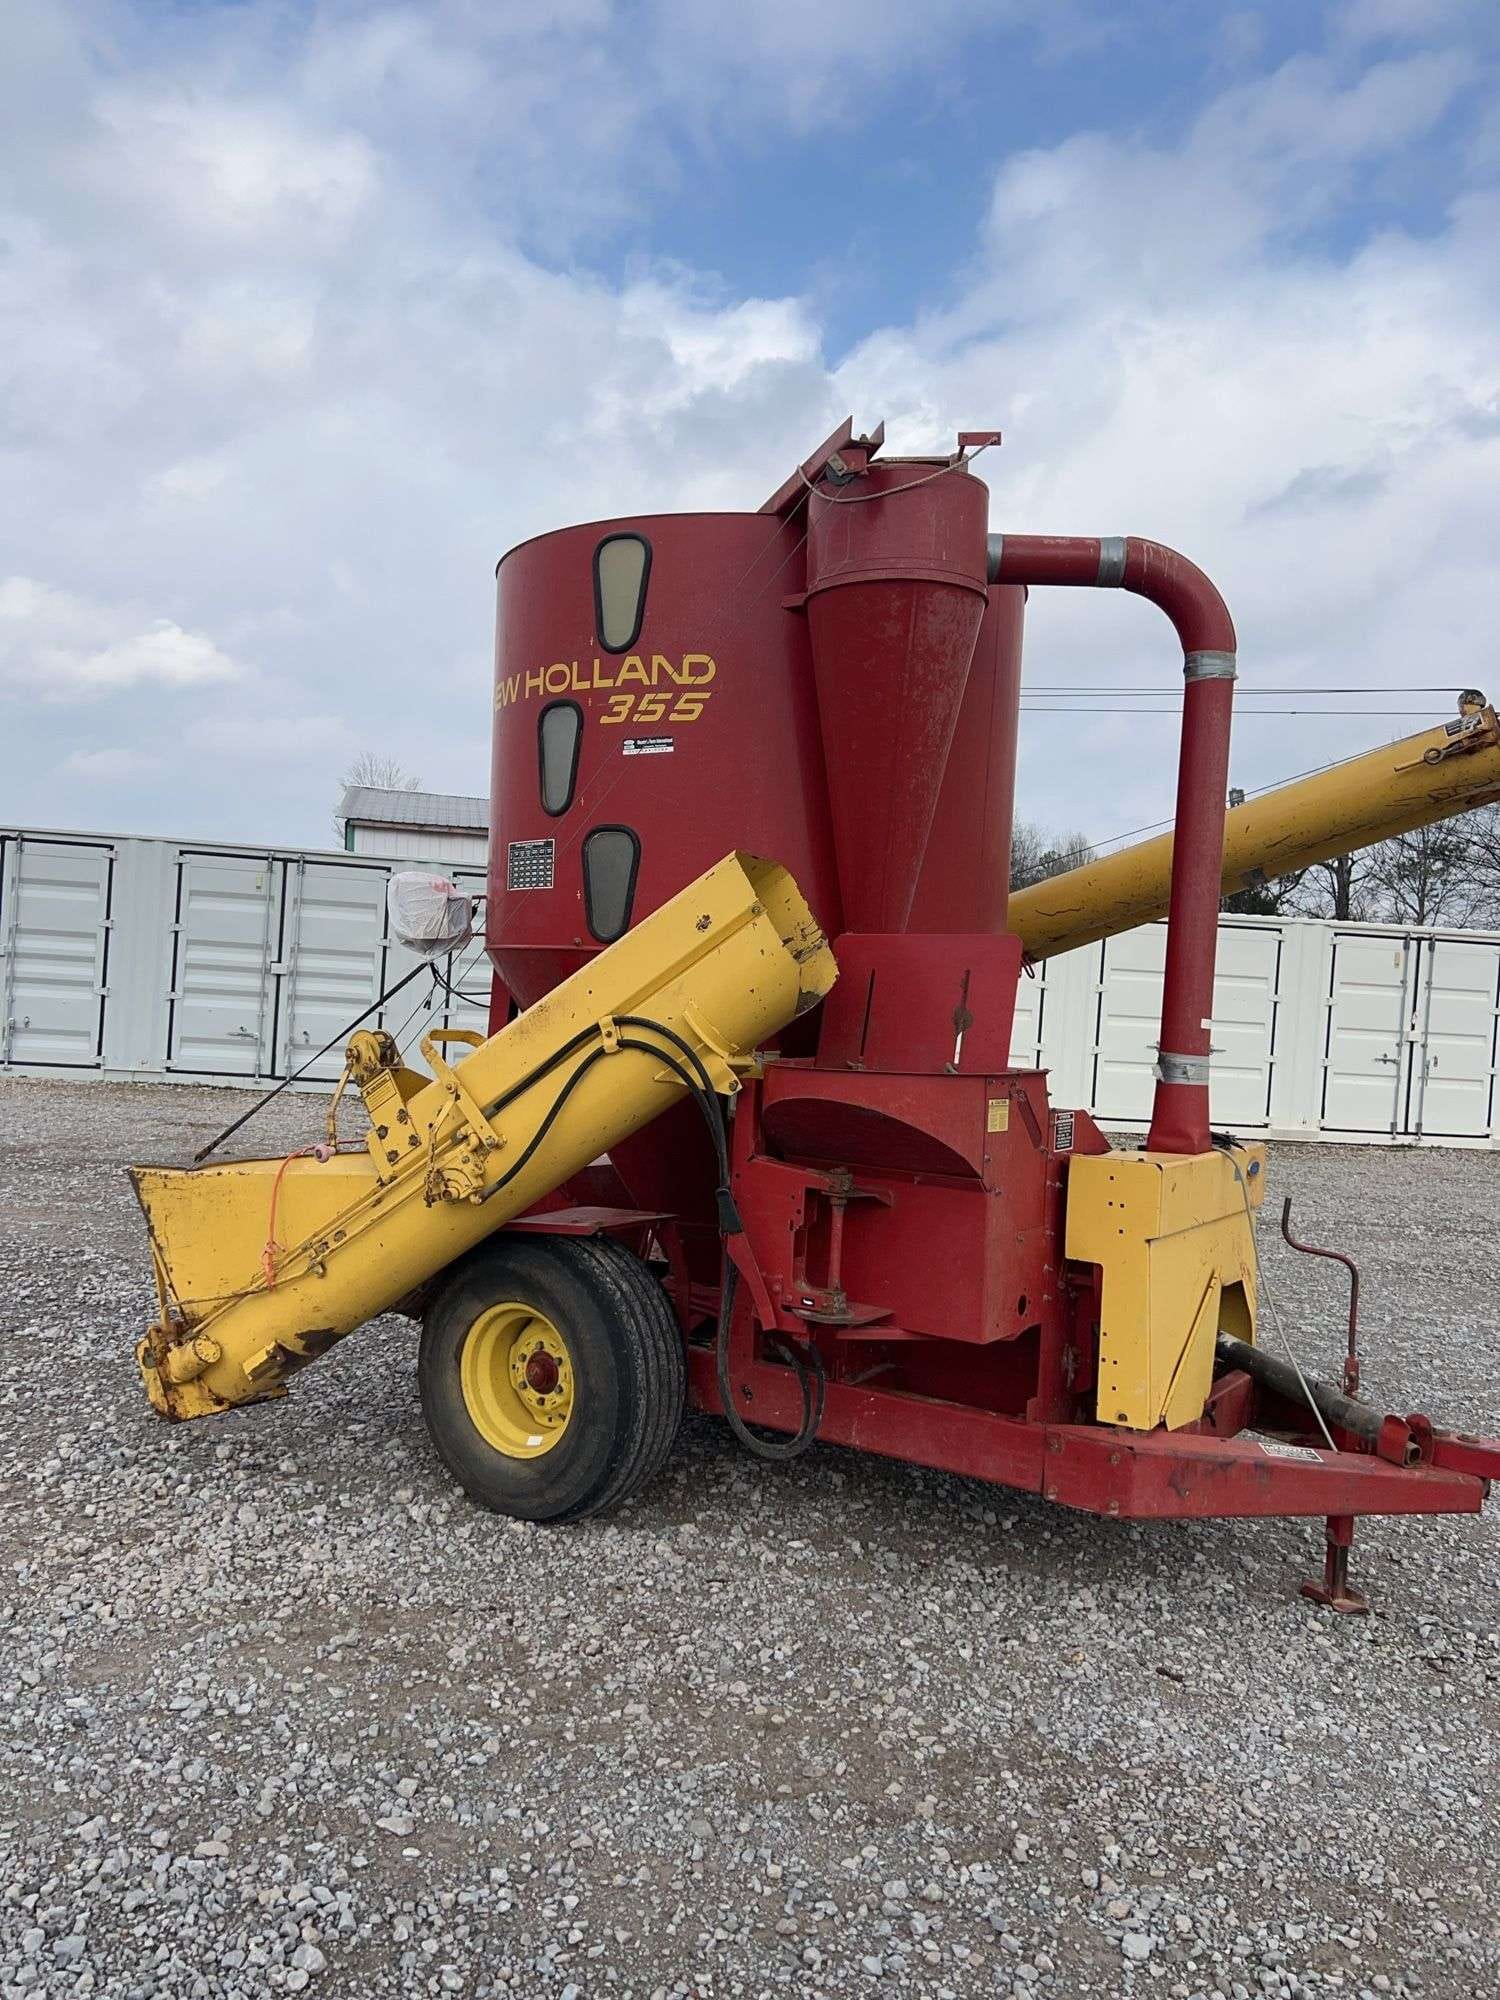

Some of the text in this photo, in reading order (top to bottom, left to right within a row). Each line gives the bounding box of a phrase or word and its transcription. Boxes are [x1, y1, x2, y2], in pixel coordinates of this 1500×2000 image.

[495, 654, 717, 712] EW HOLLAND
[600, 692, 711, 724] 355
